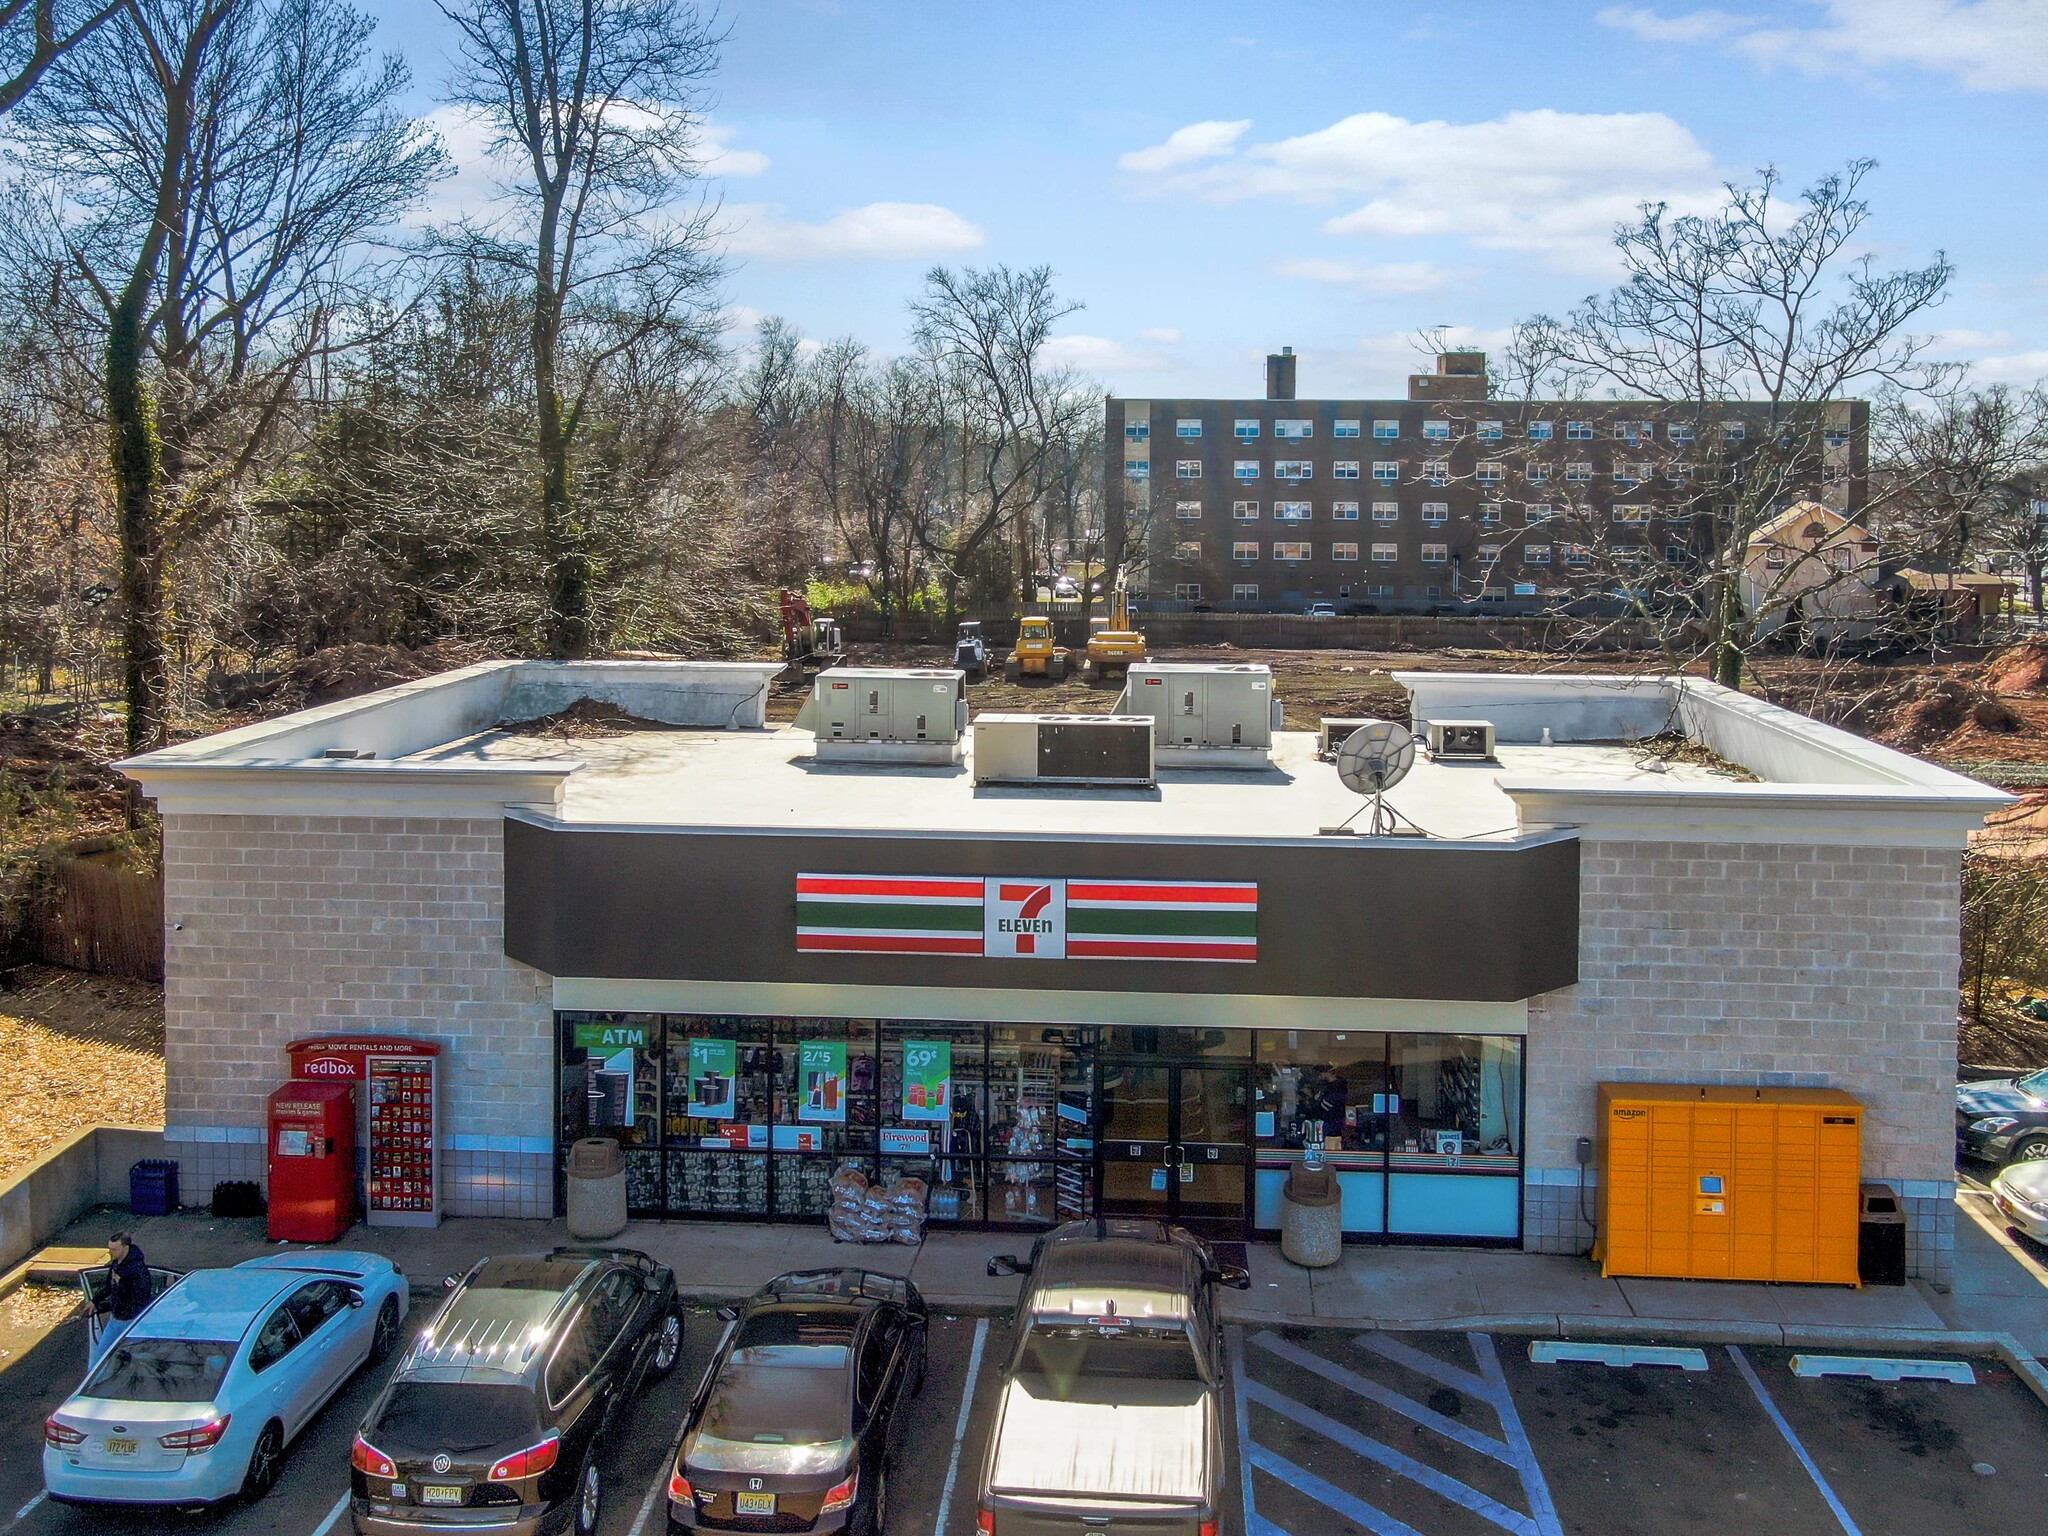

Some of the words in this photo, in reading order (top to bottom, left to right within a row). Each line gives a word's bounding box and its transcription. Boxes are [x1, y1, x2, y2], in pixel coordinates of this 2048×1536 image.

[999, 884, 1052, 954] 7
[601, 1029, 643, 1045] ATM
[349, 1044, 378, 1052] RENTALS
[693, 1047, 708, 1065] $1
[803, 1050, 831, 1063] 2/$5
[906, 1050, 937, 1067] 69¢
[304, 1062, 354, 1075] redbox
[292, 1102, 321, 1110] RELEASE
[1613, 1109, 1646, 1117] amazon
[883, 1132, 928, 1143] Firewood
